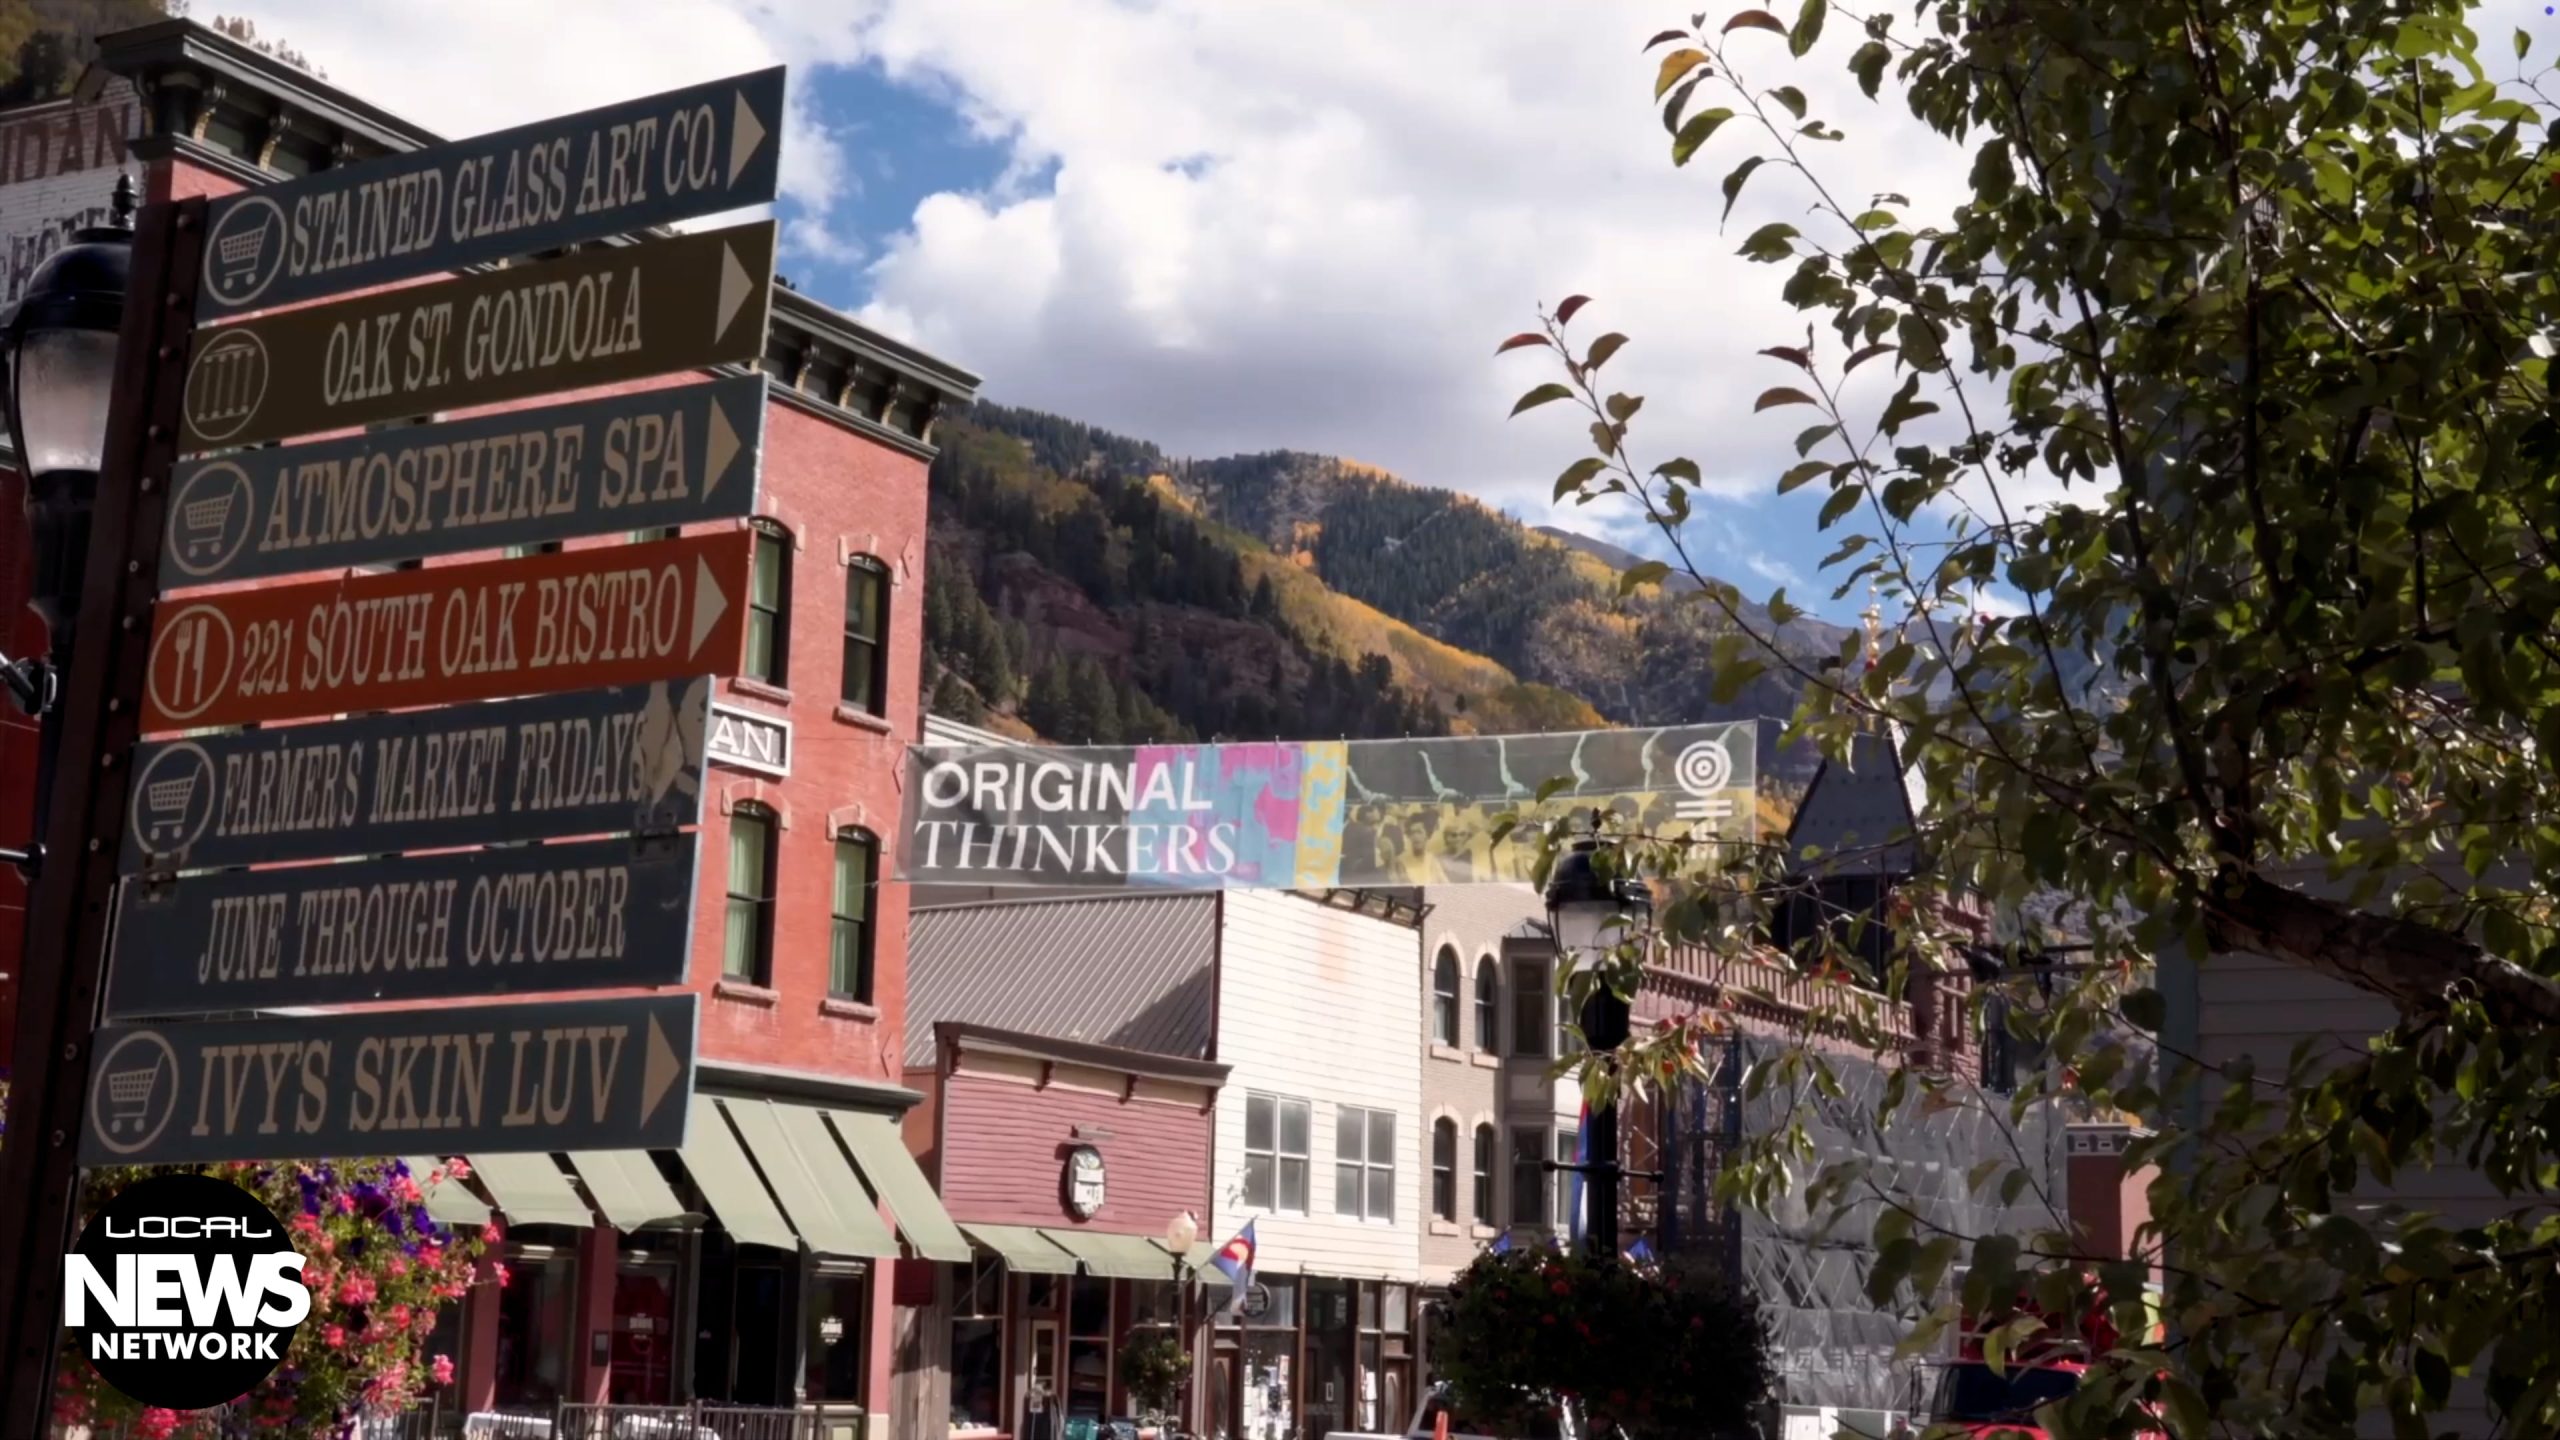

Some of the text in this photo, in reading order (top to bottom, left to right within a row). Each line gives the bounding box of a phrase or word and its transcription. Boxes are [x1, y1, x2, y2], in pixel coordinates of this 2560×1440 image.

[289, 104, 718, 277] STAINED GLASS ART CO.
[323, 266, 643, 406] OAK ST. GONDOLA
[258, 410, 690, 552] ATMOSPHERE SPA
[237, 564, 683, 698] 221 SOUTH OAK BISTRO
[216, 740, 365, 837] FARMERS
[369, 726, 507, 824] MARKET
[922, 761, 1213, 811] ORIGINAL
[914, 819, 1236, 874] THINKERS
[199, 866, 629, 984] JUNE THROUGH OCTOBER
[191, 1025, 628, 1136] IVY'S SKIN LUV
